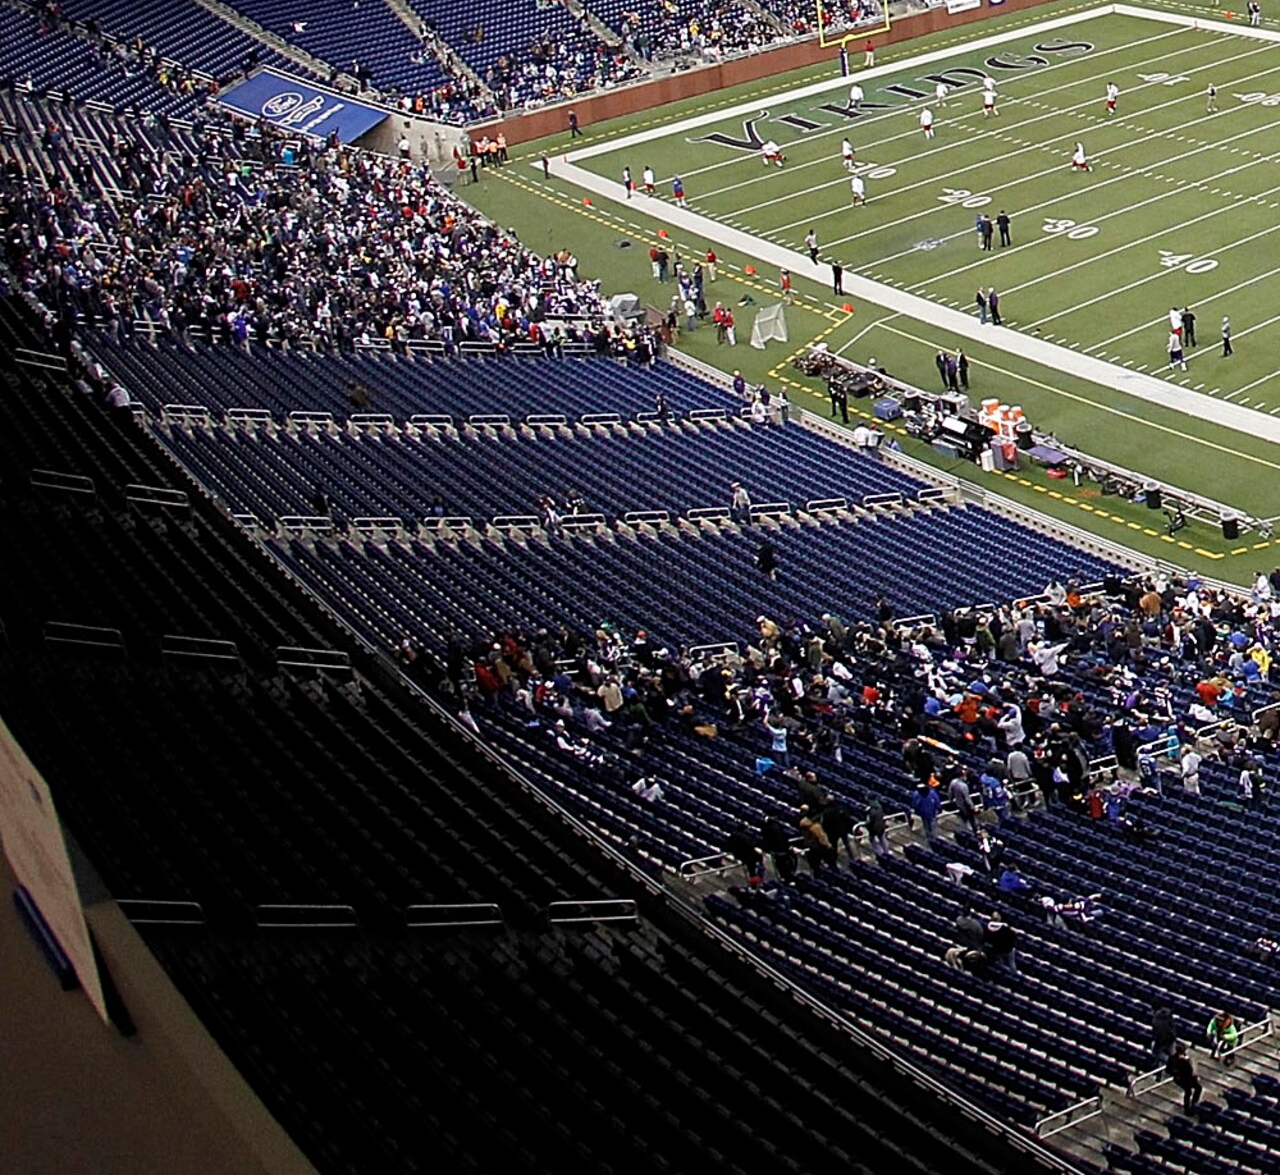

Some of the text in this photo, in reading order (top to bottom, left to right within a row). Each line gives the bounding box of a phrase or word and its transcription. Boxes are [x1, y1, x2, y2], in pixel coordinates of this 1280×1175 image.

[685, 38, 1095, 151] VIKINGS
[937, 189, 993, 208] 20
[1042, 220, 1100, 240] 30
[1160, 253, 1219, 274] 40
